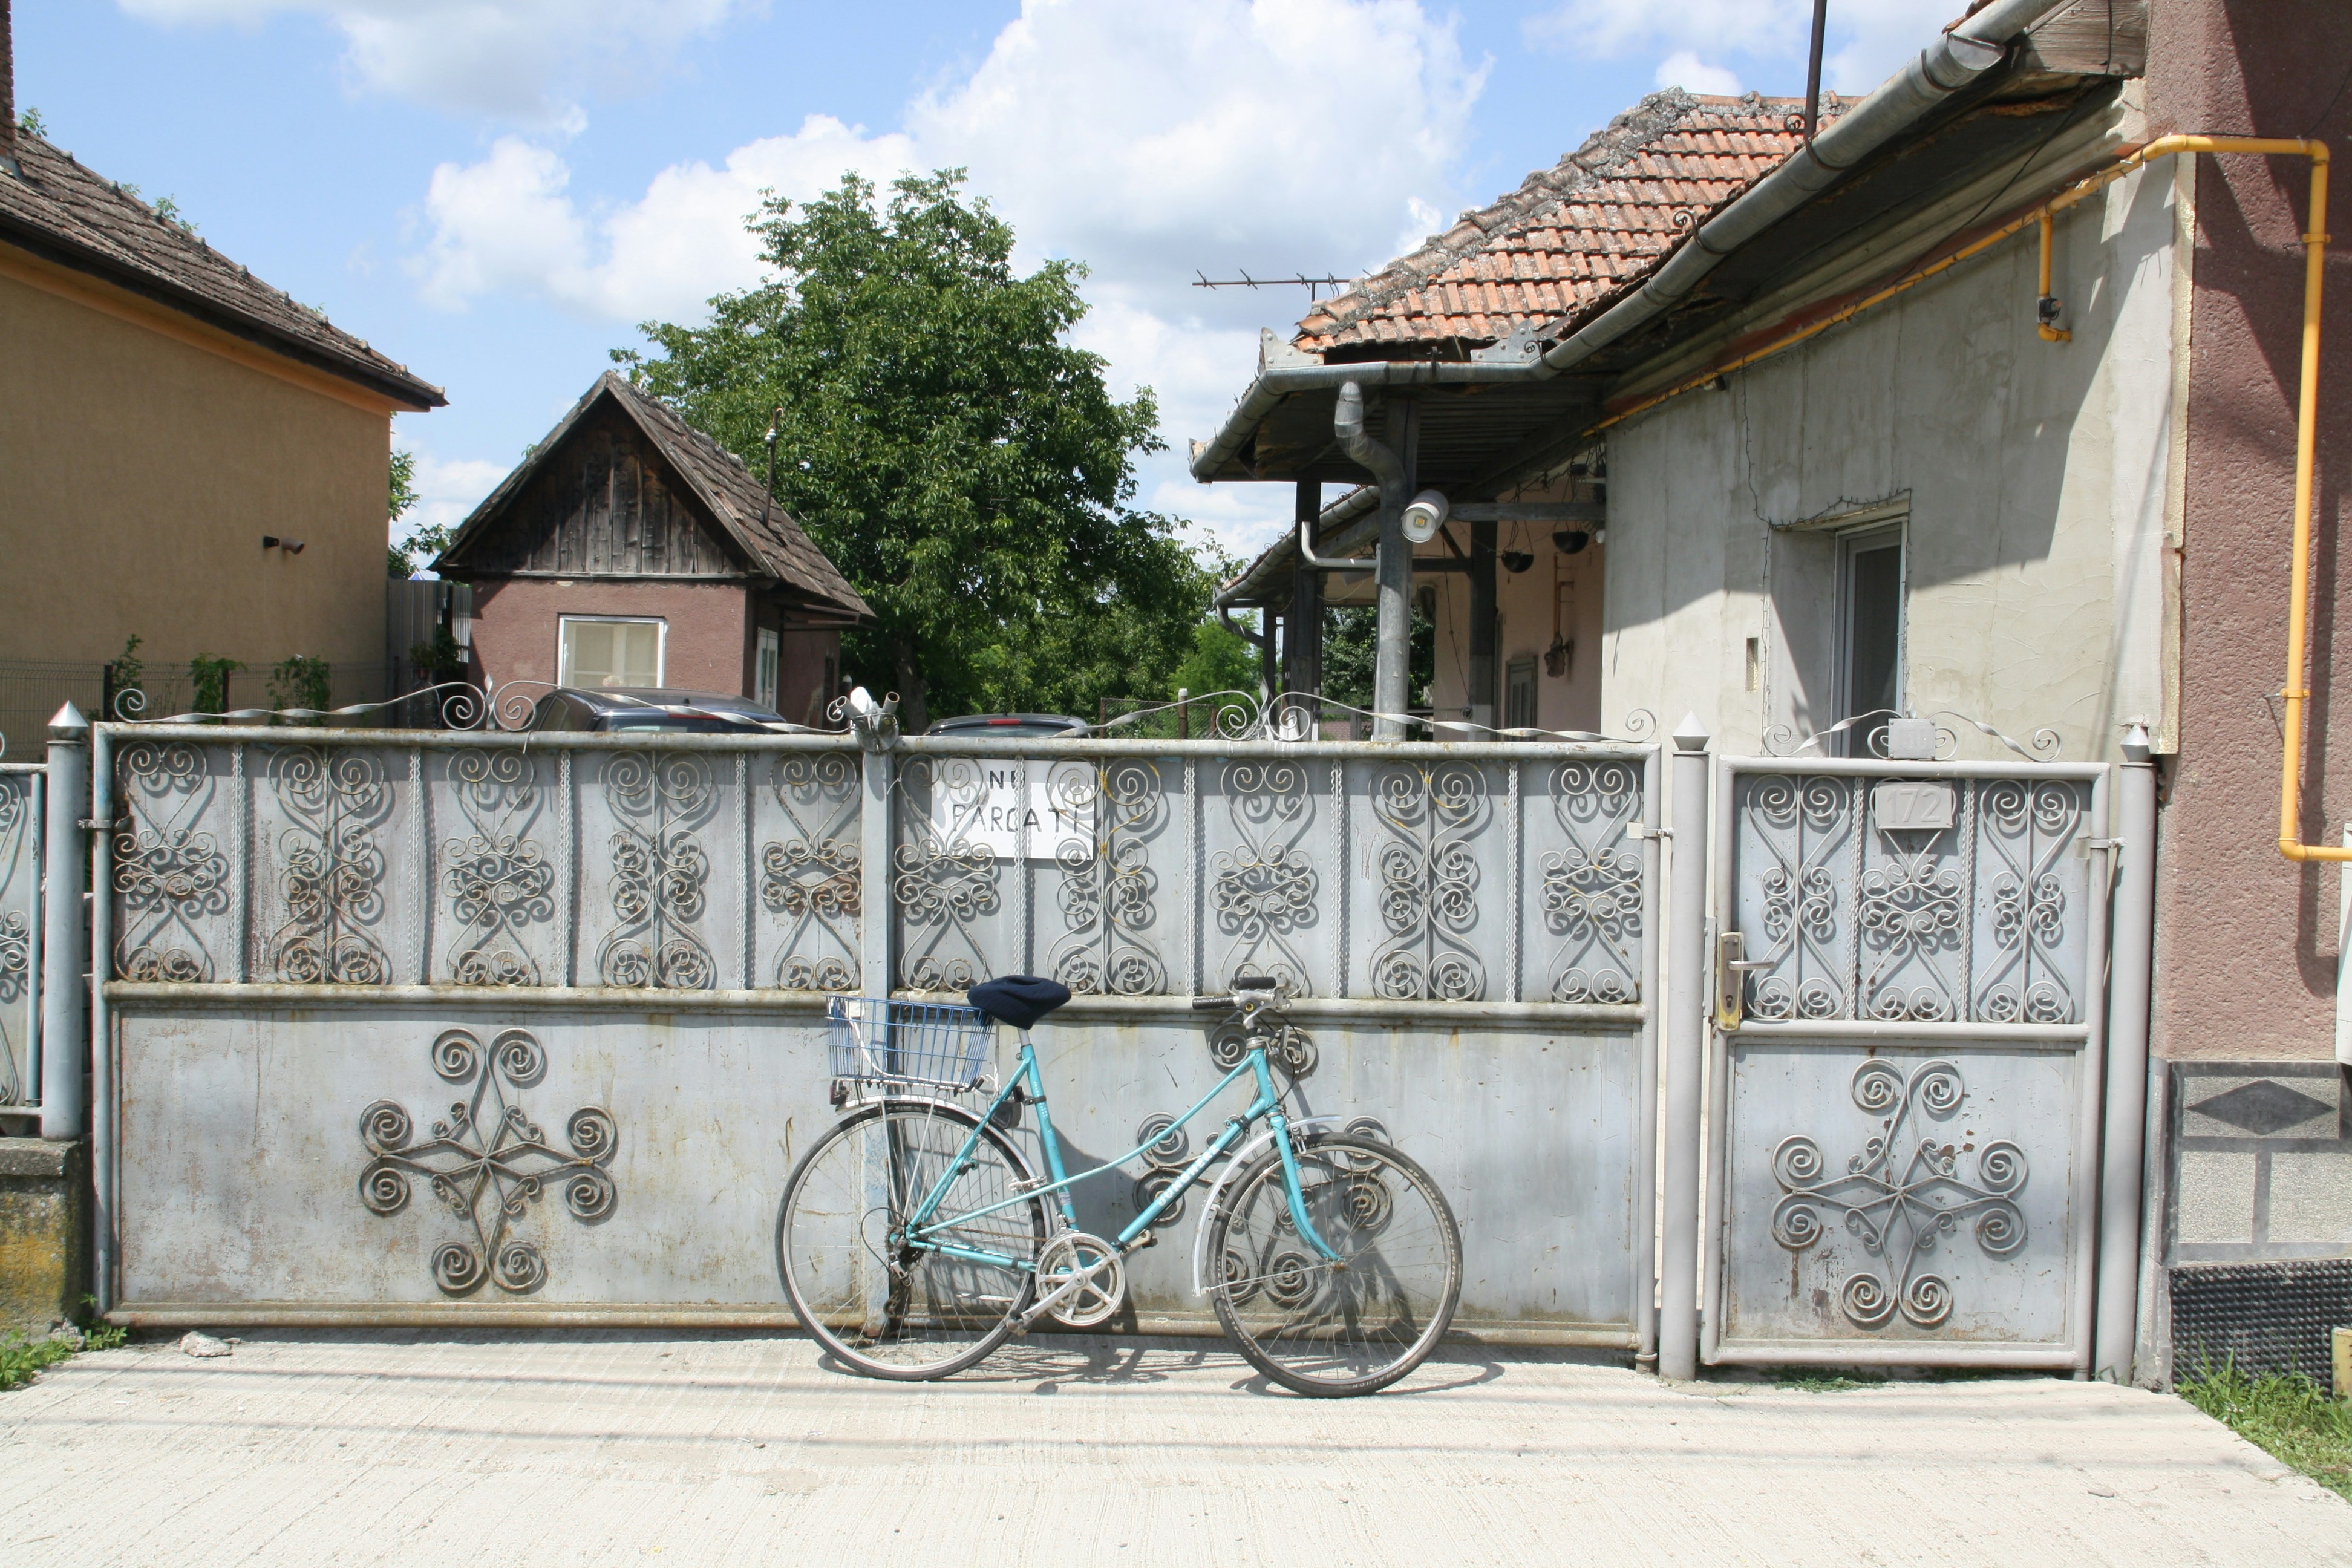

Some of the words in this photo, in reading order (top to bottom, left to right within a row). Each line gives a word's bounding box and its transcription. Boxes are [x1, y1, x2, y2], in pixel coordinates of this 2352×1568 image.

[1886, 788, 1941, 823] 172
[1157, 1144, 1220, 1206] JUNGHERZ
[1351, 1363, 1406, 1388] MARATHON
